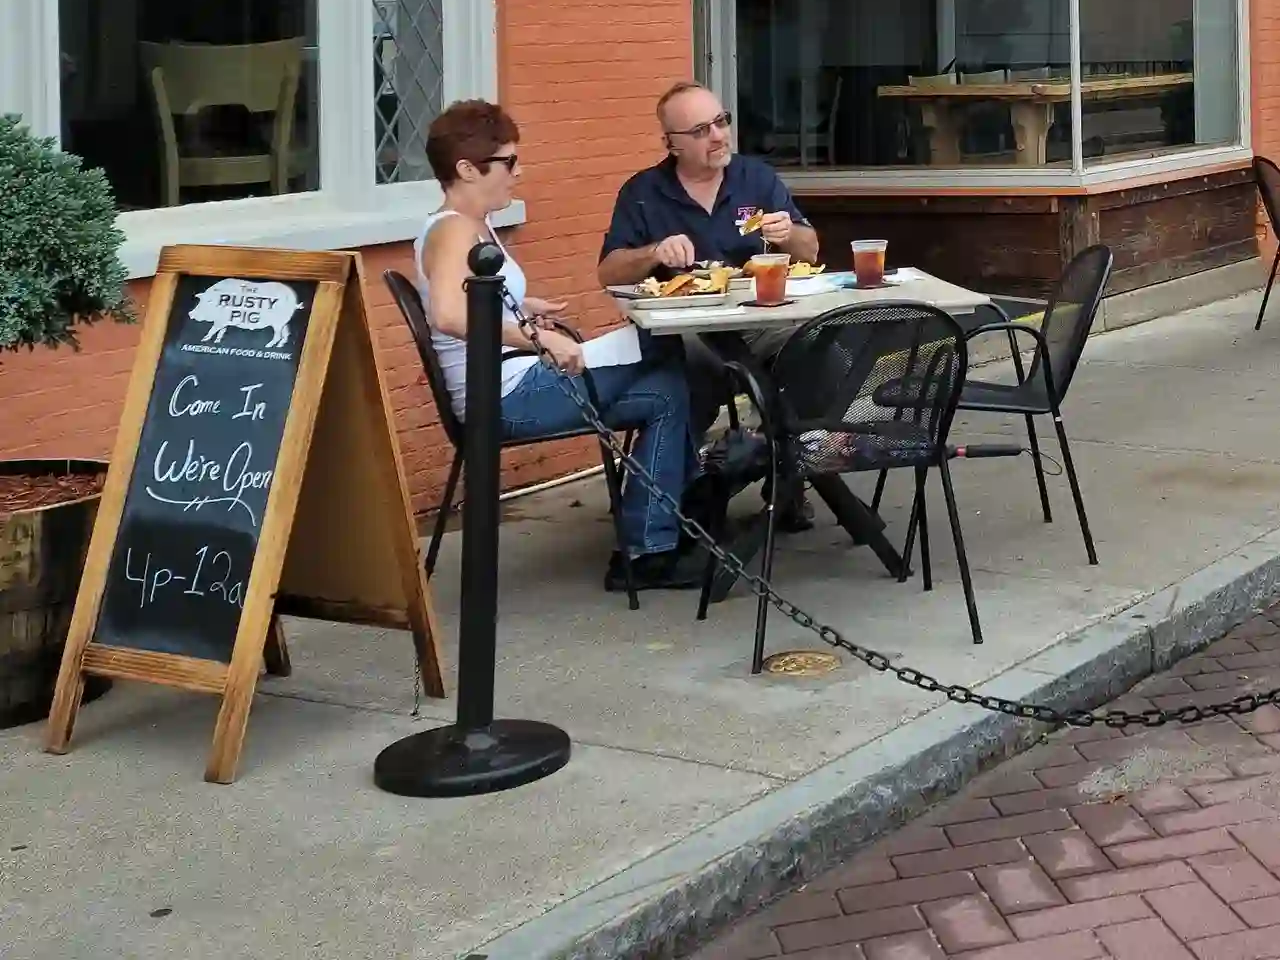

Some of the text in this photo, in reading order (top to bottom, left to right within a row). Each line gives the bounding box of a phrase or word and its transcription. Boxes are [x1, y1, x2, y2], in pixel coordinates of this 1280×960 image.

[240, 285, 258, 294] THE
[218, 294, 279, 310] RUSTY
[230, 310, 261, 324] PIG
[180, 343, 293, 361] AMERICAN FOOD & DRINK
[168, 374, 266, 421] Come In
[154, 439, 272, 506] We're Open
